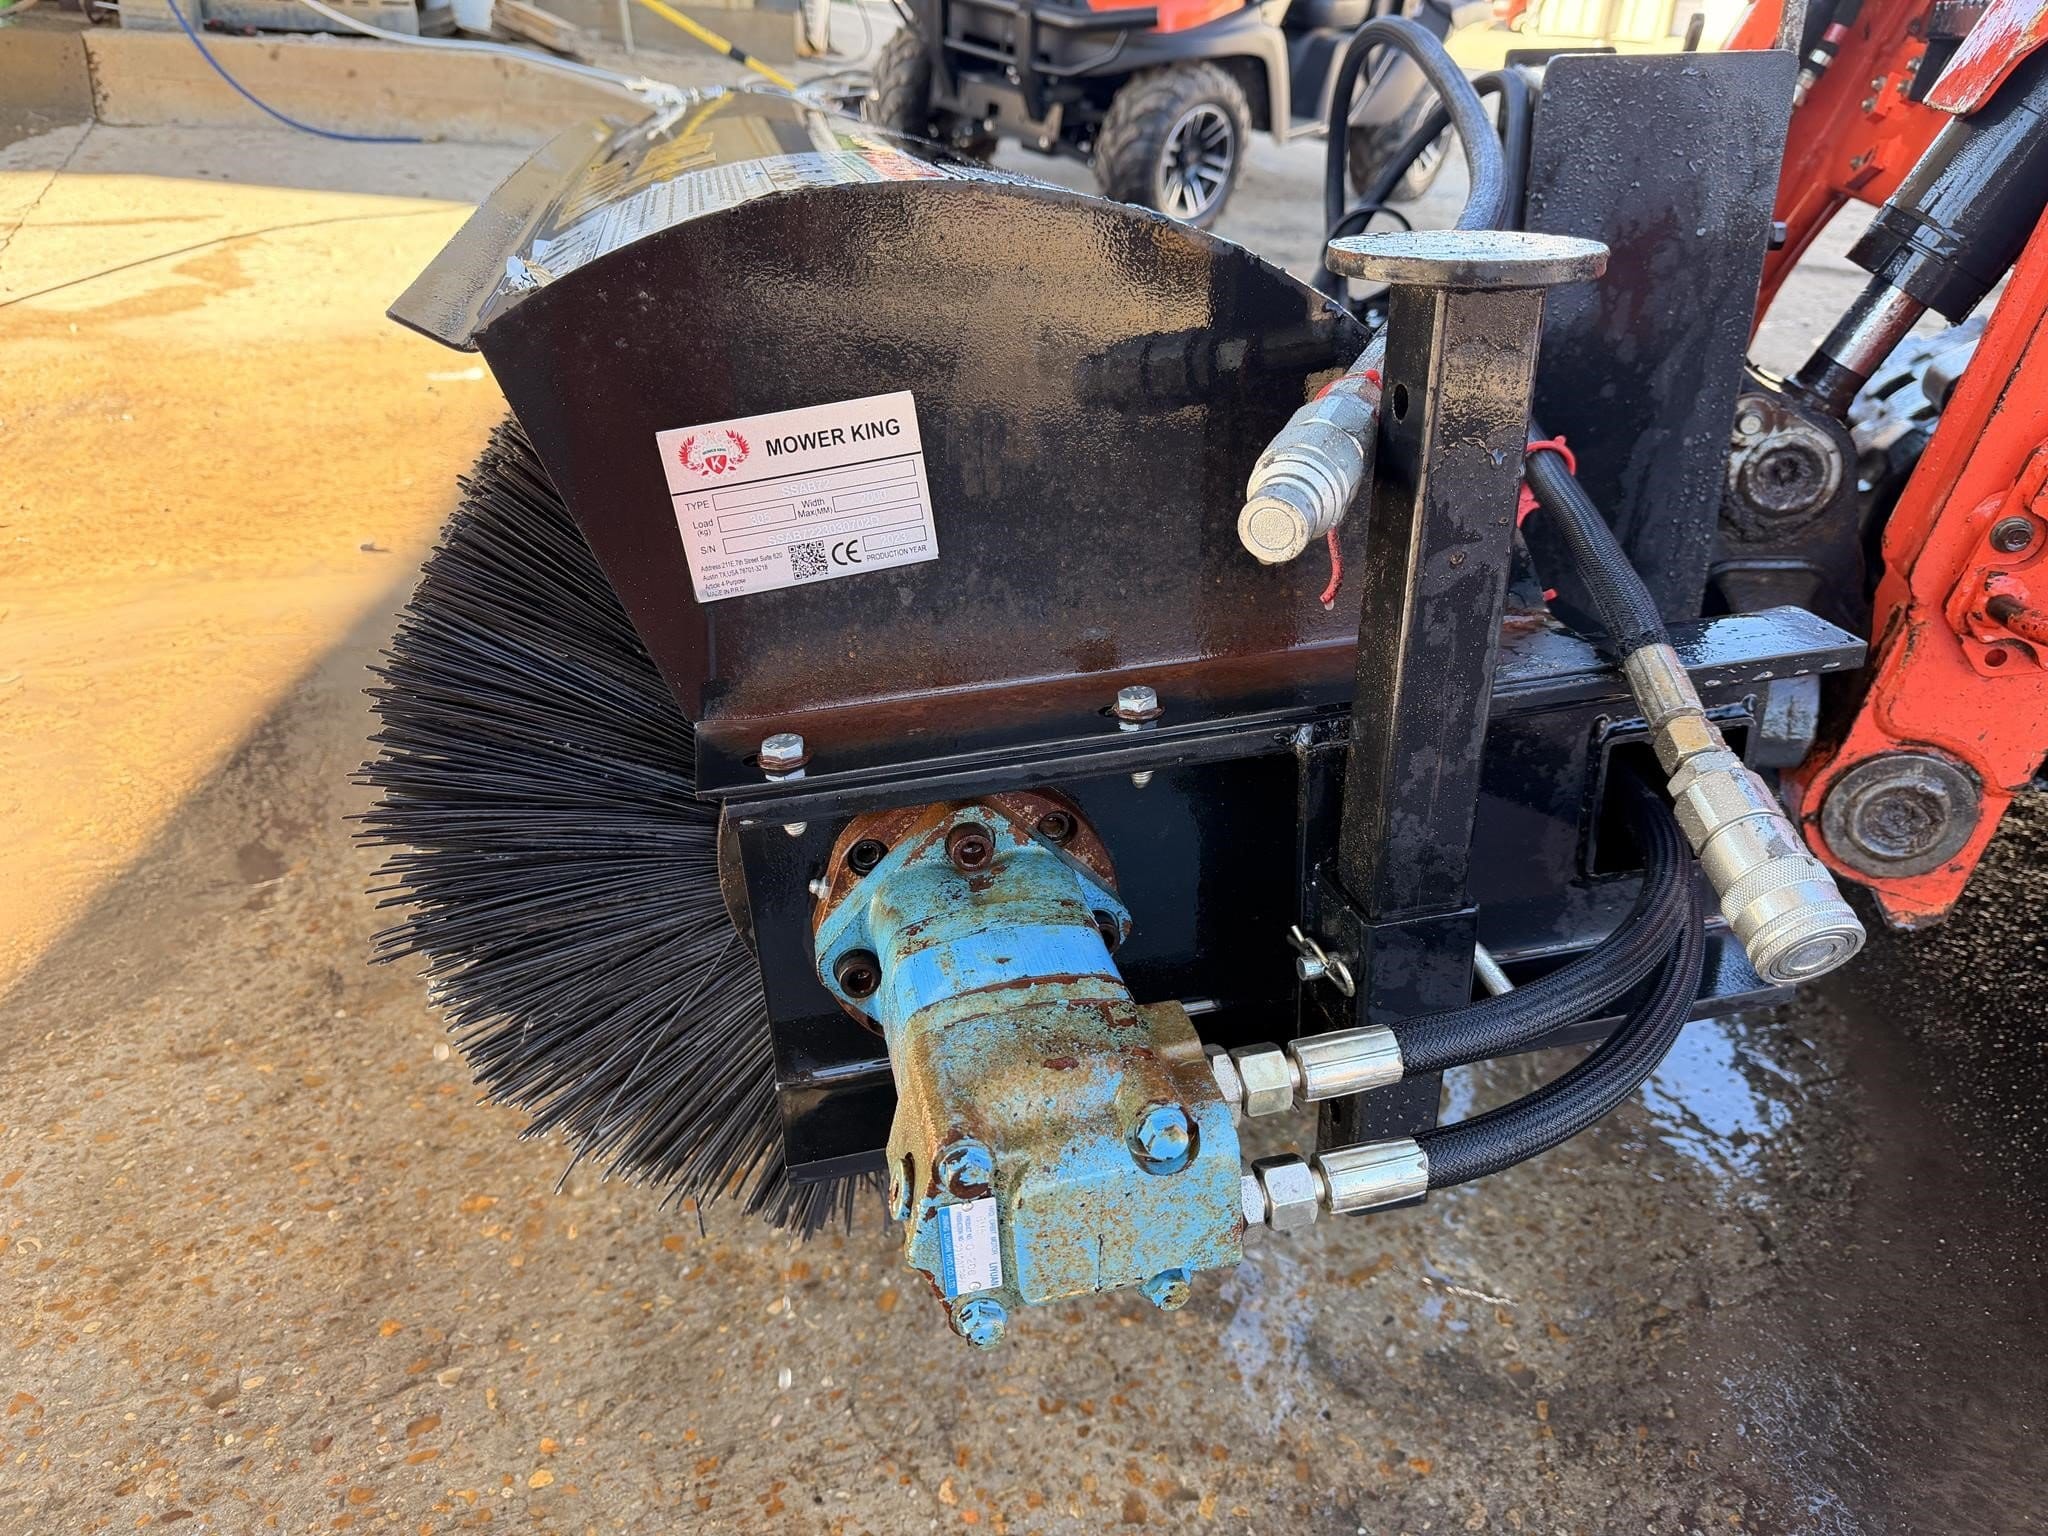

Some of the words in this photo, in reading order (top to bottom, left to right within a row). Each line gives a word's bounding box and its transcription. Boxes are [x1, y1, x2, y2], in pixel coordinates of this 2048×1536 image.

[765, 427, 846, 457] MOWER
[850, 418, 901, 443] KING
[710, 456, 724, 470] K
[781, 479, 831, 497] SSAB72
[685, 500, 710, 511] TYPE
[801, 497, 826, 509] Width
[797, 506, 833, 519] Max(MM)
[692, 519, 714, 530] Load
[697, 529, 712, 538] (kg)
[880, 533, 907, 546] 2023
[700, 545, 716, 555] S/N
[832, 539, 862, 565] CE
[867, 549, 909, 562] PRODUCTION
[909, 544, 927, 554] YEAR
[703, 573, 719, 581] Austin
[707, 590, 723, 598] MADE
